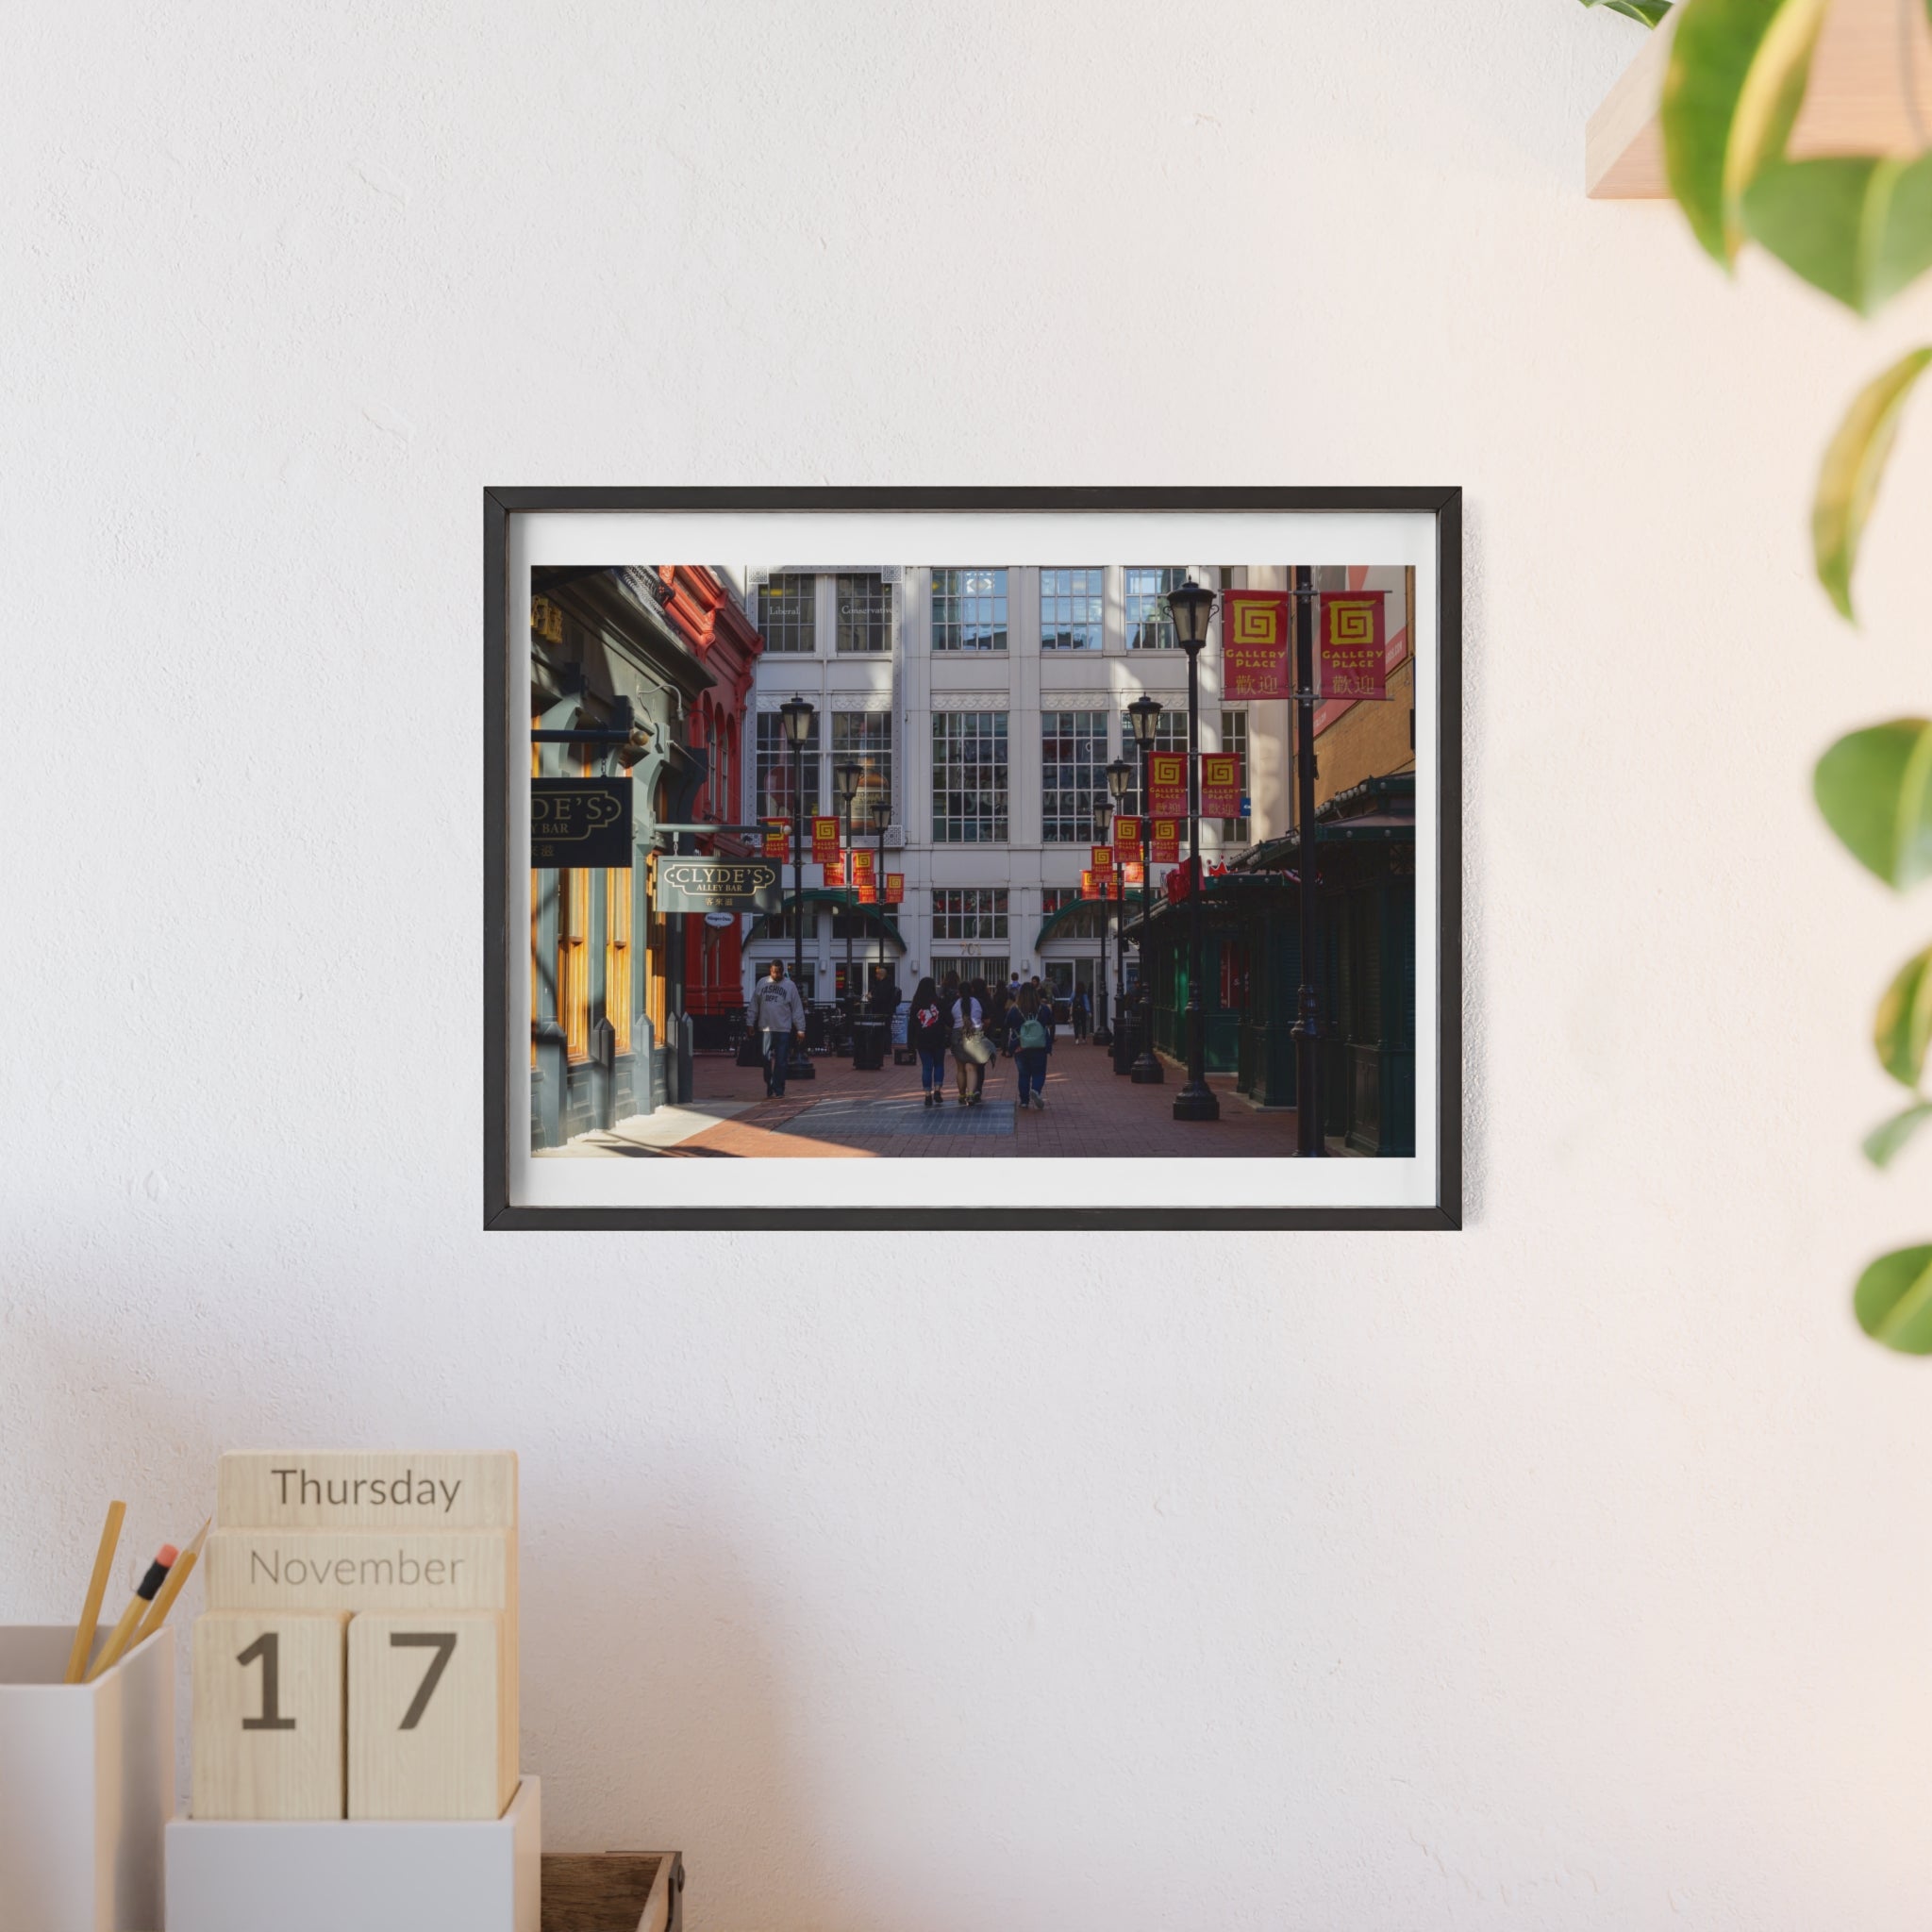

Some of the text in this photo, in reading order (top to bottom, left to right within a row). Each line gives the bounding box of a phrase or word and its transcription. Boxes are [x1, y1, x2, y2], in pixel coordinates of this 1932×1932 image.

[1225, 649, 1285, 658] GALLERY
[1322, 650, 1384, 658] GALLERY
[1236, 658, 1276, 668] PLACE
[1332, 659, 1374, 668] PLACE
[542, 823, 569, 834] BAR
[676, 868, 763, 884] CLYDE'S
[760, 985, 788, 1000] FASHION
[271, 1469, 462, 1511] Thursday
[250, 1549, 464, 1585] November
[236, 1632, 458, 1730] 1 7
